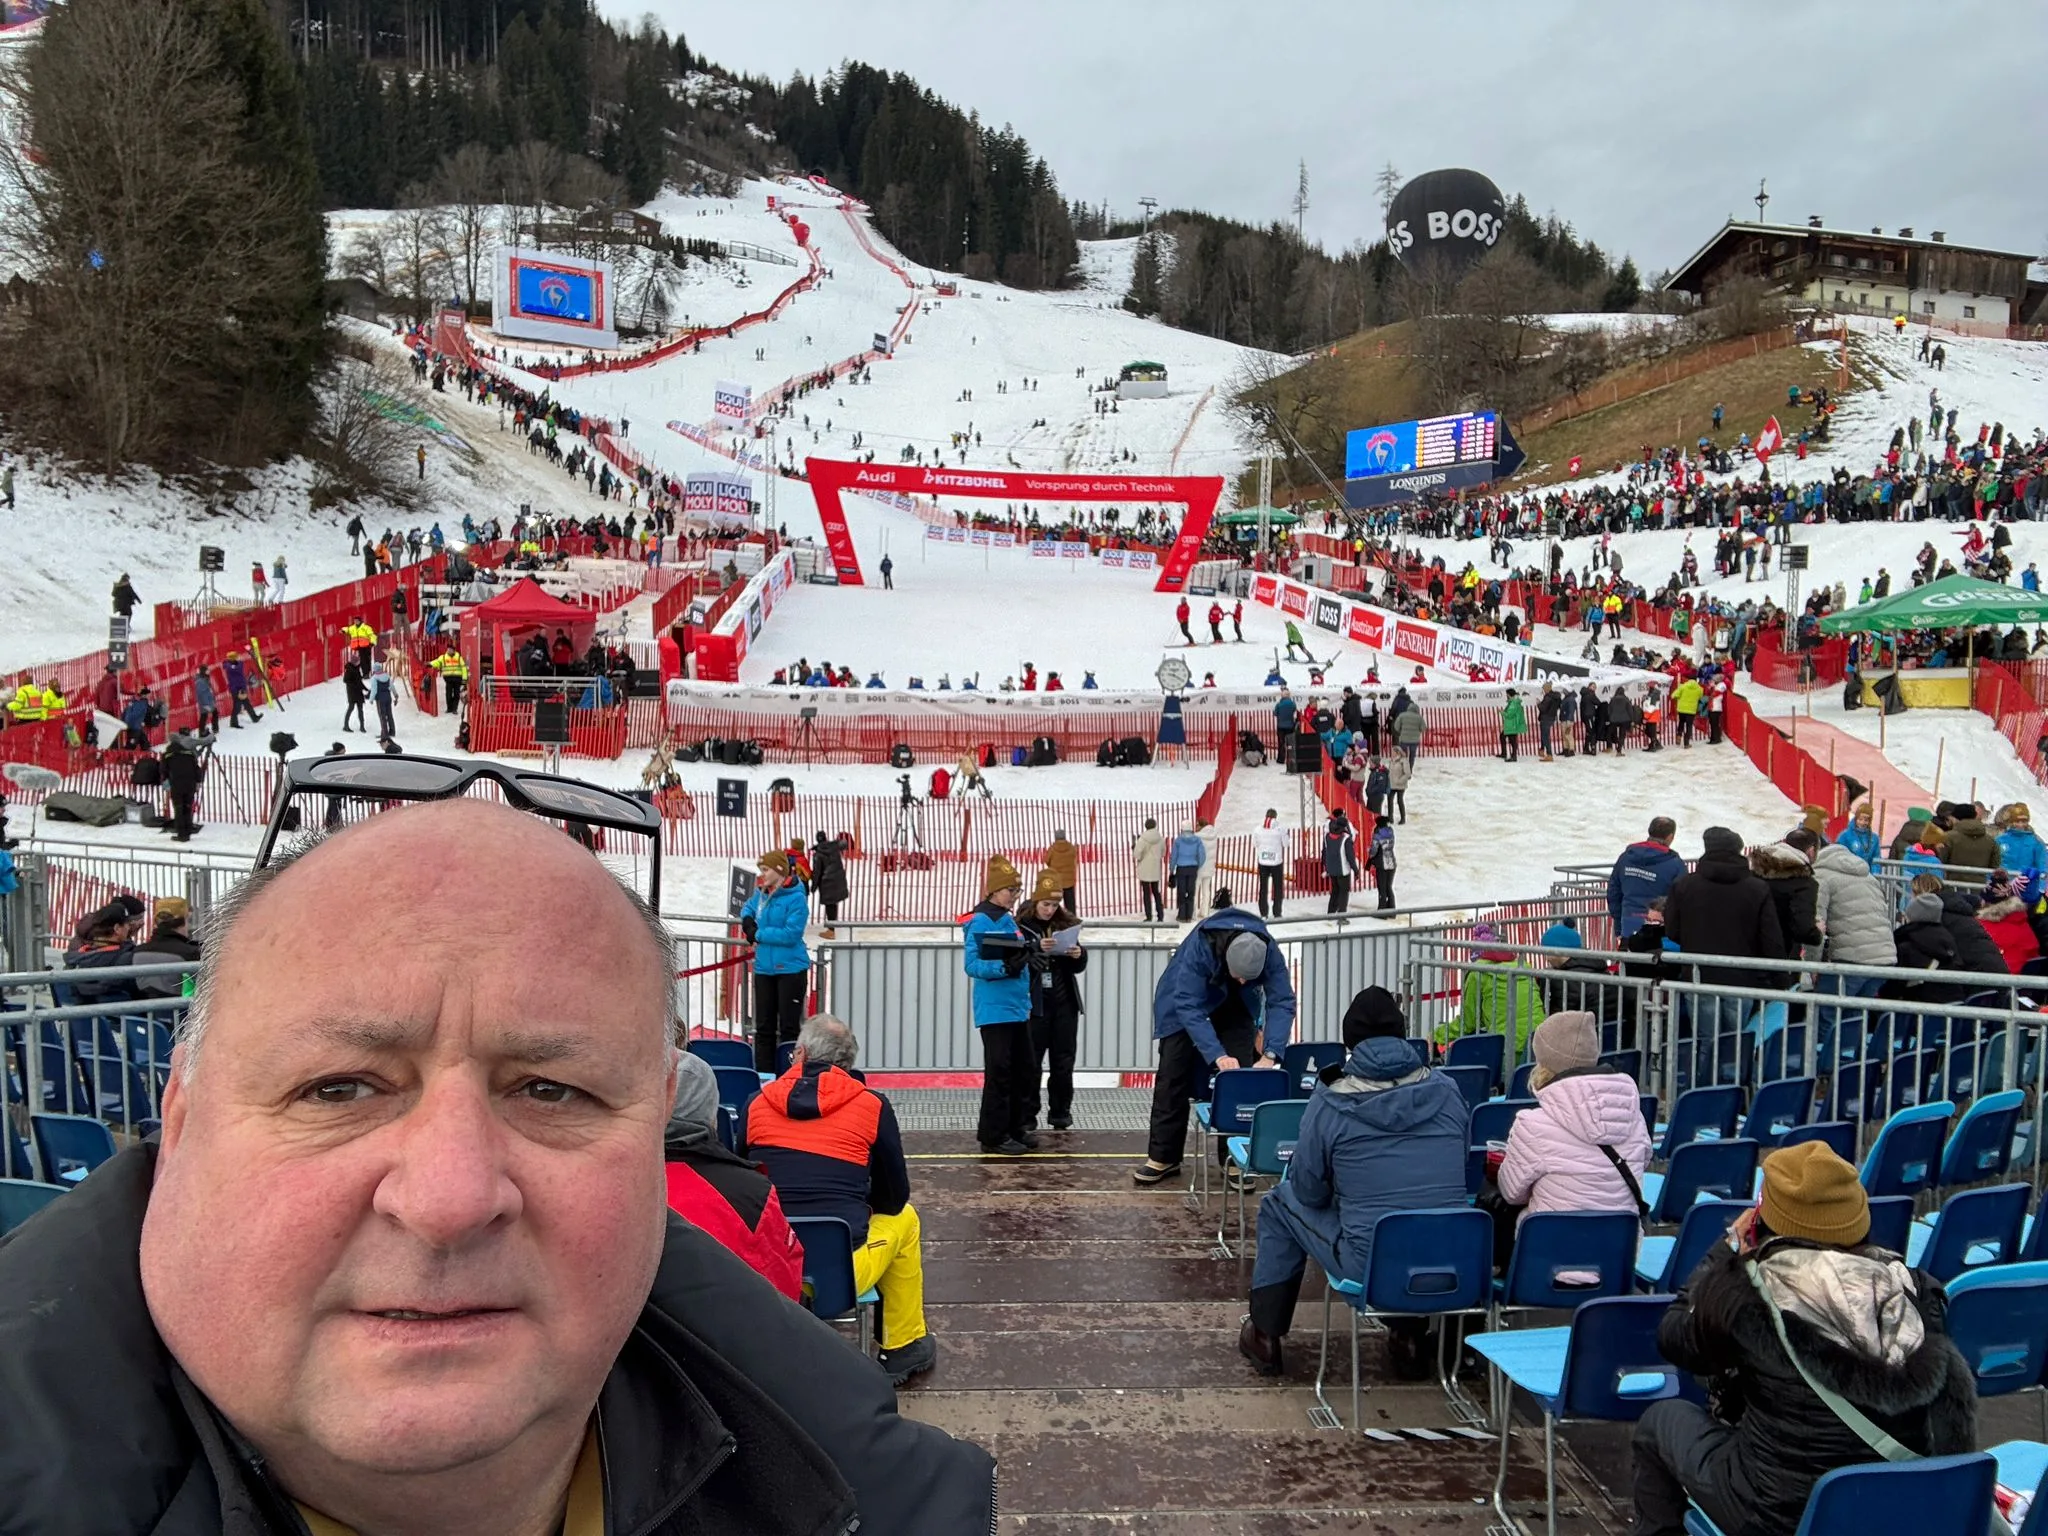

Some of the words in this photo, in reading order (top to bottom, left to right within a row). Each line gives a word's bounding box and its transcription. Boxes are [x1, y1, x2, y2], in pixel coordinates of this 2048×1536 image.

[1427, 208, 1503, 246] BOSS
[716, 392, 744, 407] LIQUI
[715, 403, 744, 418] MOLY
[687, 483, 714, 496] LIQUI
[856, 470, 896, 483] Audi
[1025, 479, 1090, 492] Vorsprung
[1092, 481, 1128, 491] durch
[1130, 483, 1176, 493] Technik
[1389, 473, 1446, 490] LONGINES
[718, 483, 751, 499] LIQUI
[685, 496, 714, 510] MOLY
[1319, 604, 1339, 627] BOSS
[1351, 615, 1375, 638] Austrian
[1396, 629, 1435, 658] GENERALI
[1453, 638, 1474, 658] LIQUI
[1481, 646, 1503, 667] LIQUI
[1456, 692, 1477, 700] BOSS
[727, 800, 734, 810] 3
